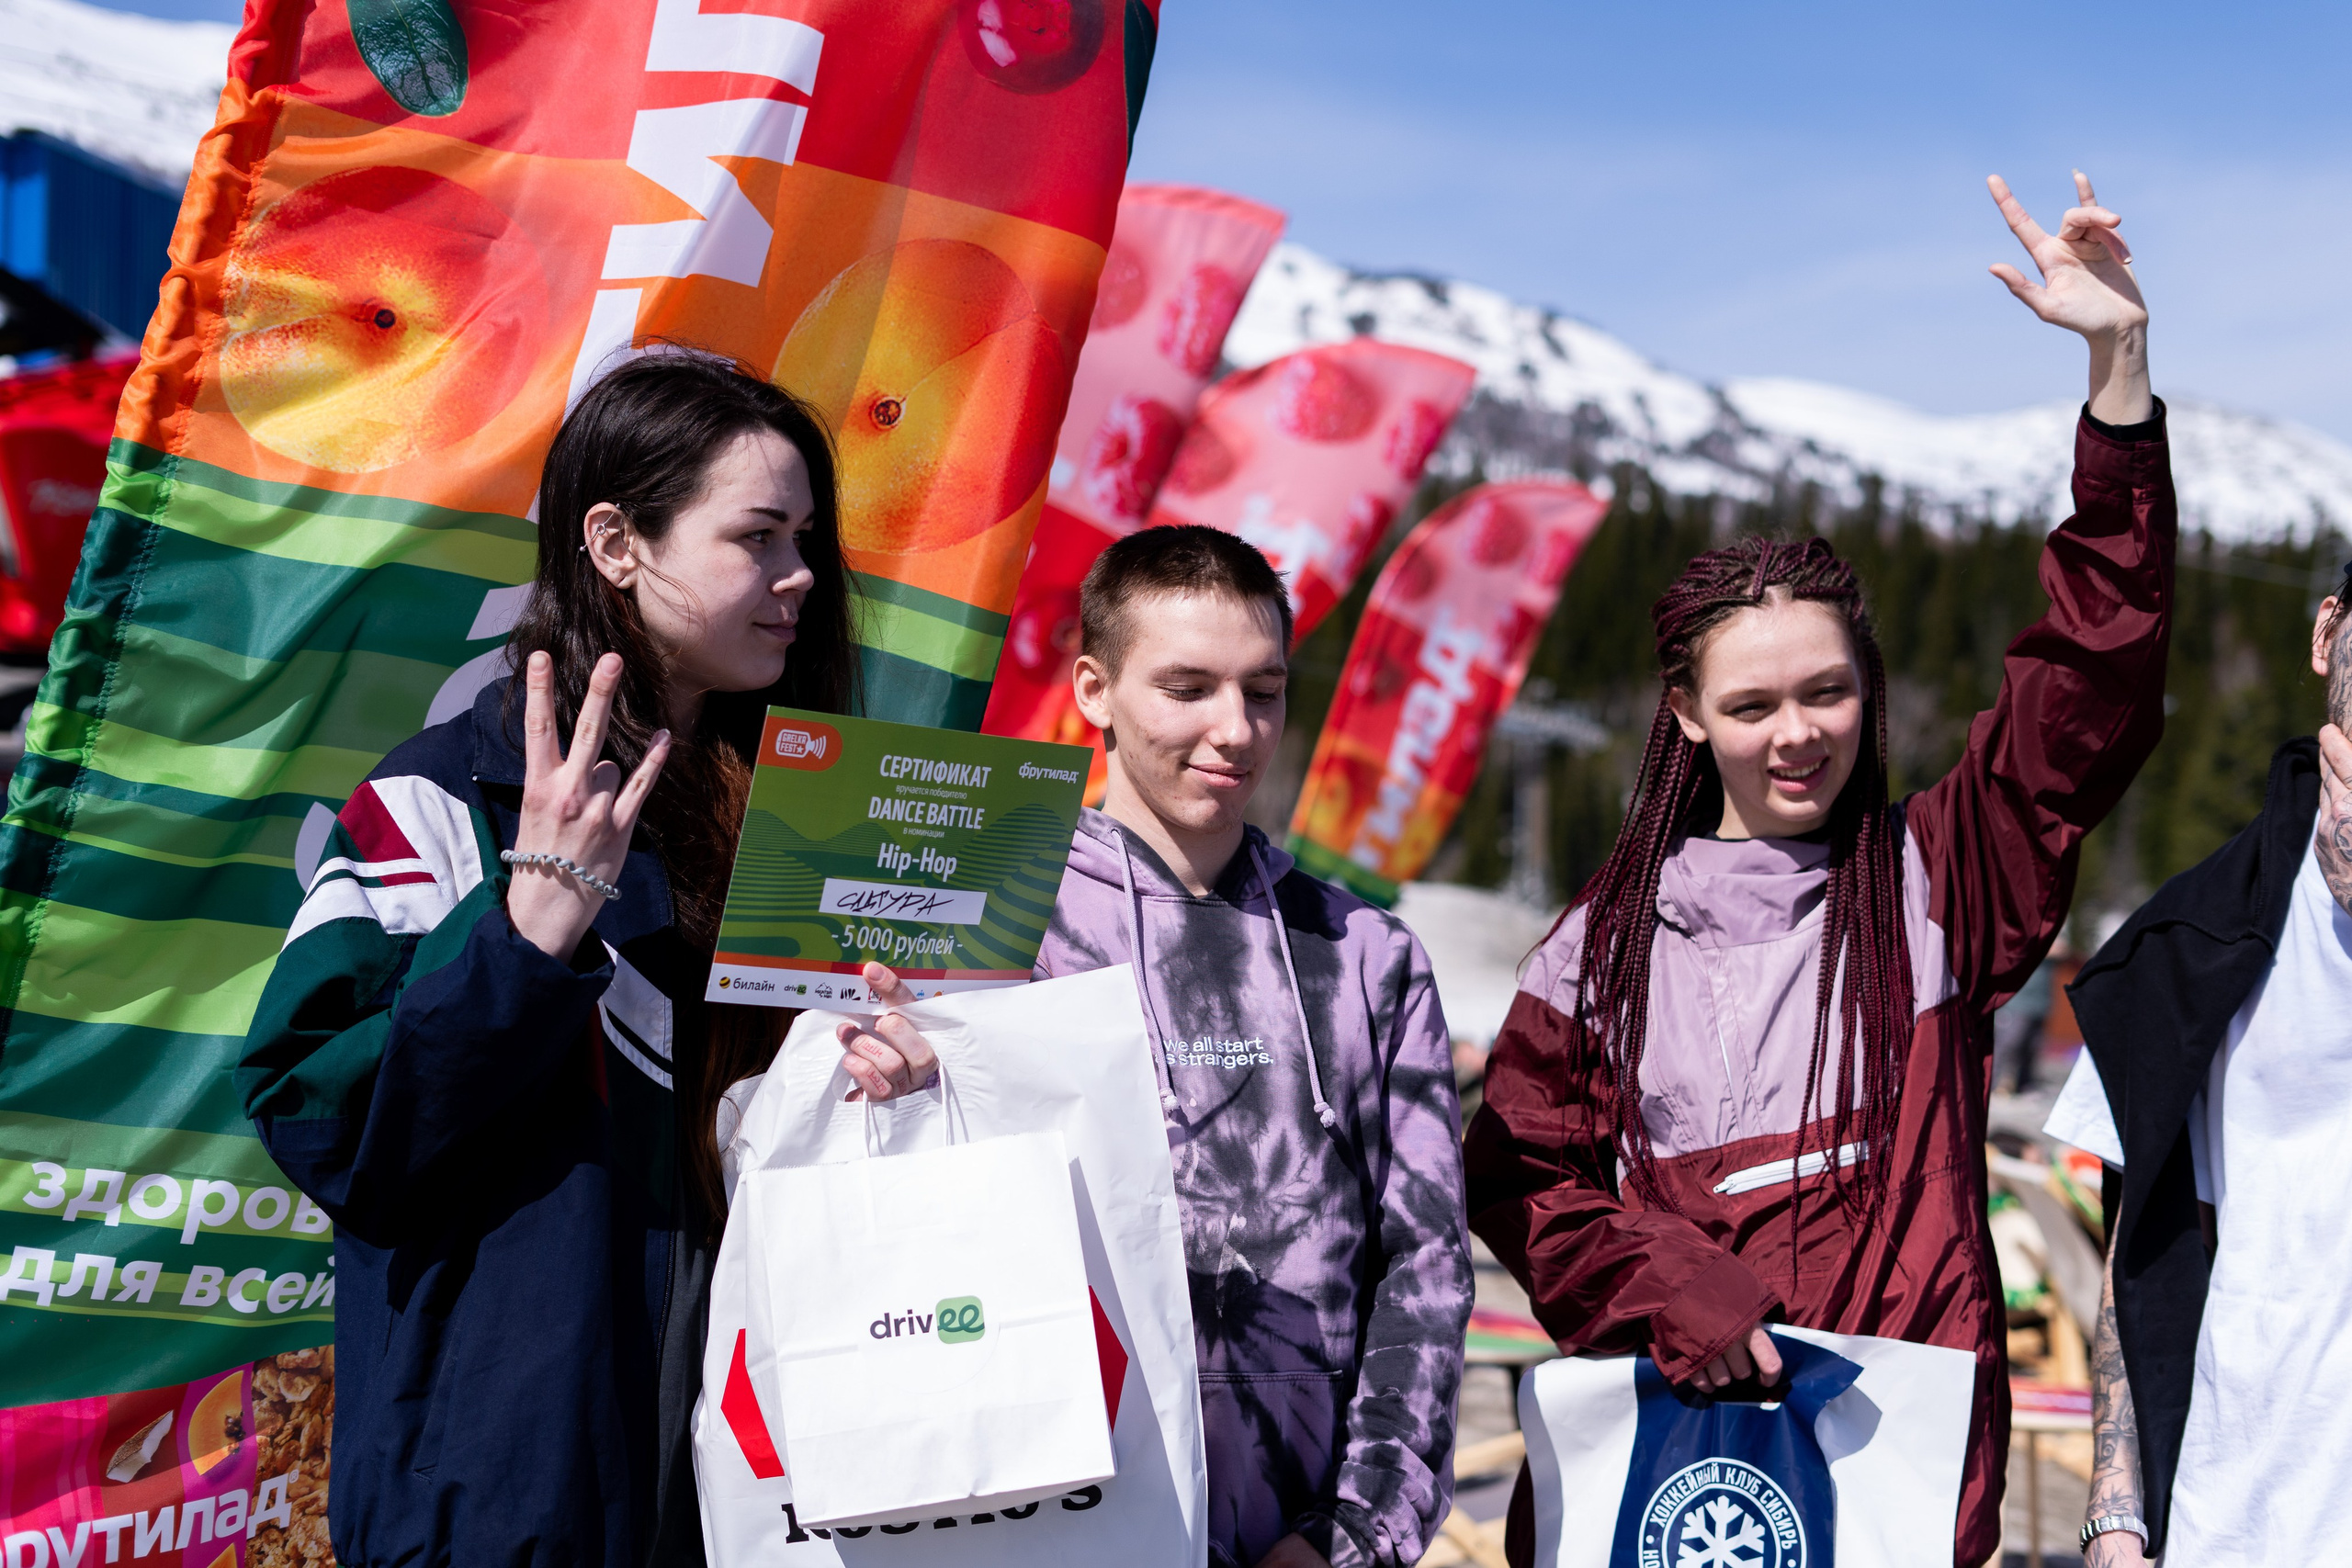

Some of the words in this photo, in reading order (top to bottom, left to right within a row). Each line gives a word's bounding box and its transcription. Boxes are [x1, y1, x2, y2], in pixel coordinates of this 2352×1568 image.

[780, 742, 797, 753] FEST
[880, 754, 992, 788] СЕРТИФИКАТ
[1018, 761, 1079, 784] фрутилад
[896, 784, 929, 795] вручается
[930, 787, 967, 799] победителю
[868, 796, 926, 823] DANCE
[926, 803, 985, 829] BATTLE
[903, 827, 909, 835] в
[908, 828, 944, 839] номинации
[876, 842, 957, 883] Hip-Hop
[893, 931, 954, 960] рублей
[733, 977, 775, 992] билайн
[1163, 1039, 1190, 1052] We
[1193, 1036, 1213, 1052] all
[1216, 1036, 1263, 1053] start
[0, 1245, 164, 1307] для
[869, 1302, 984, 1341] drivee
[1649, 1461, 1720, 1529] ХОККЕЙНЫЙ
[1724, 1466, 1762, 1495] КЛУБ
[1759, 1489, 1798, 1550] СИБИРЬ
